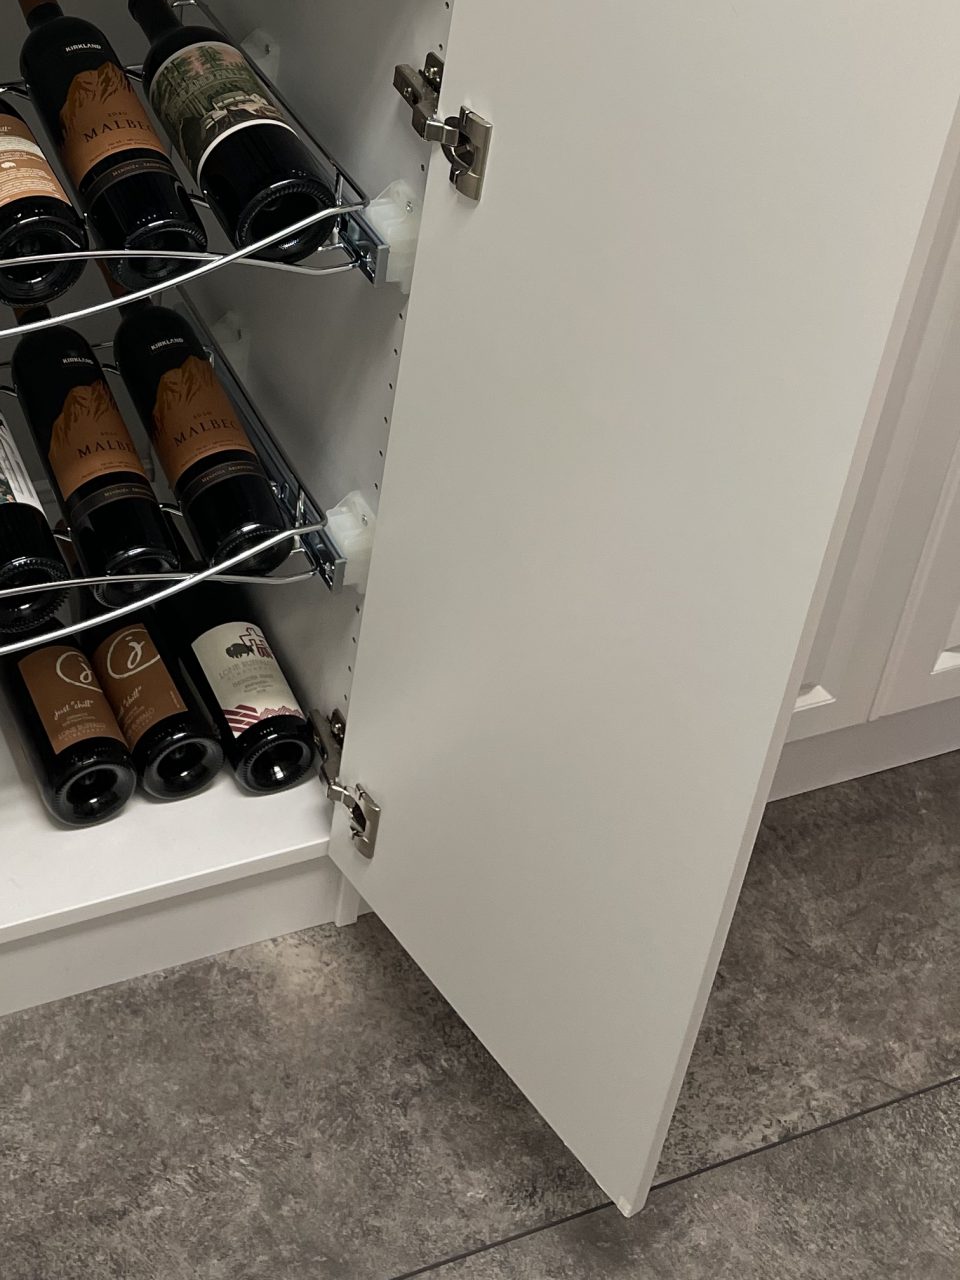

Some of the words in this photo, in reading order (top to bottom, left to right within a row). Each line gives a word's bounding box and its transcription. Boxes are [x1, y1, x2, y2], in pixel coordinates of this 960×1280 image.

[65, 43, 102, 53] KIRKLAND
[150, 337, 184, 351] KIRKLAND
[173, 418, 240, 448] MALBEC
[77, 439, 135, 459] MALBE
[54, 705, 70, 721] just
